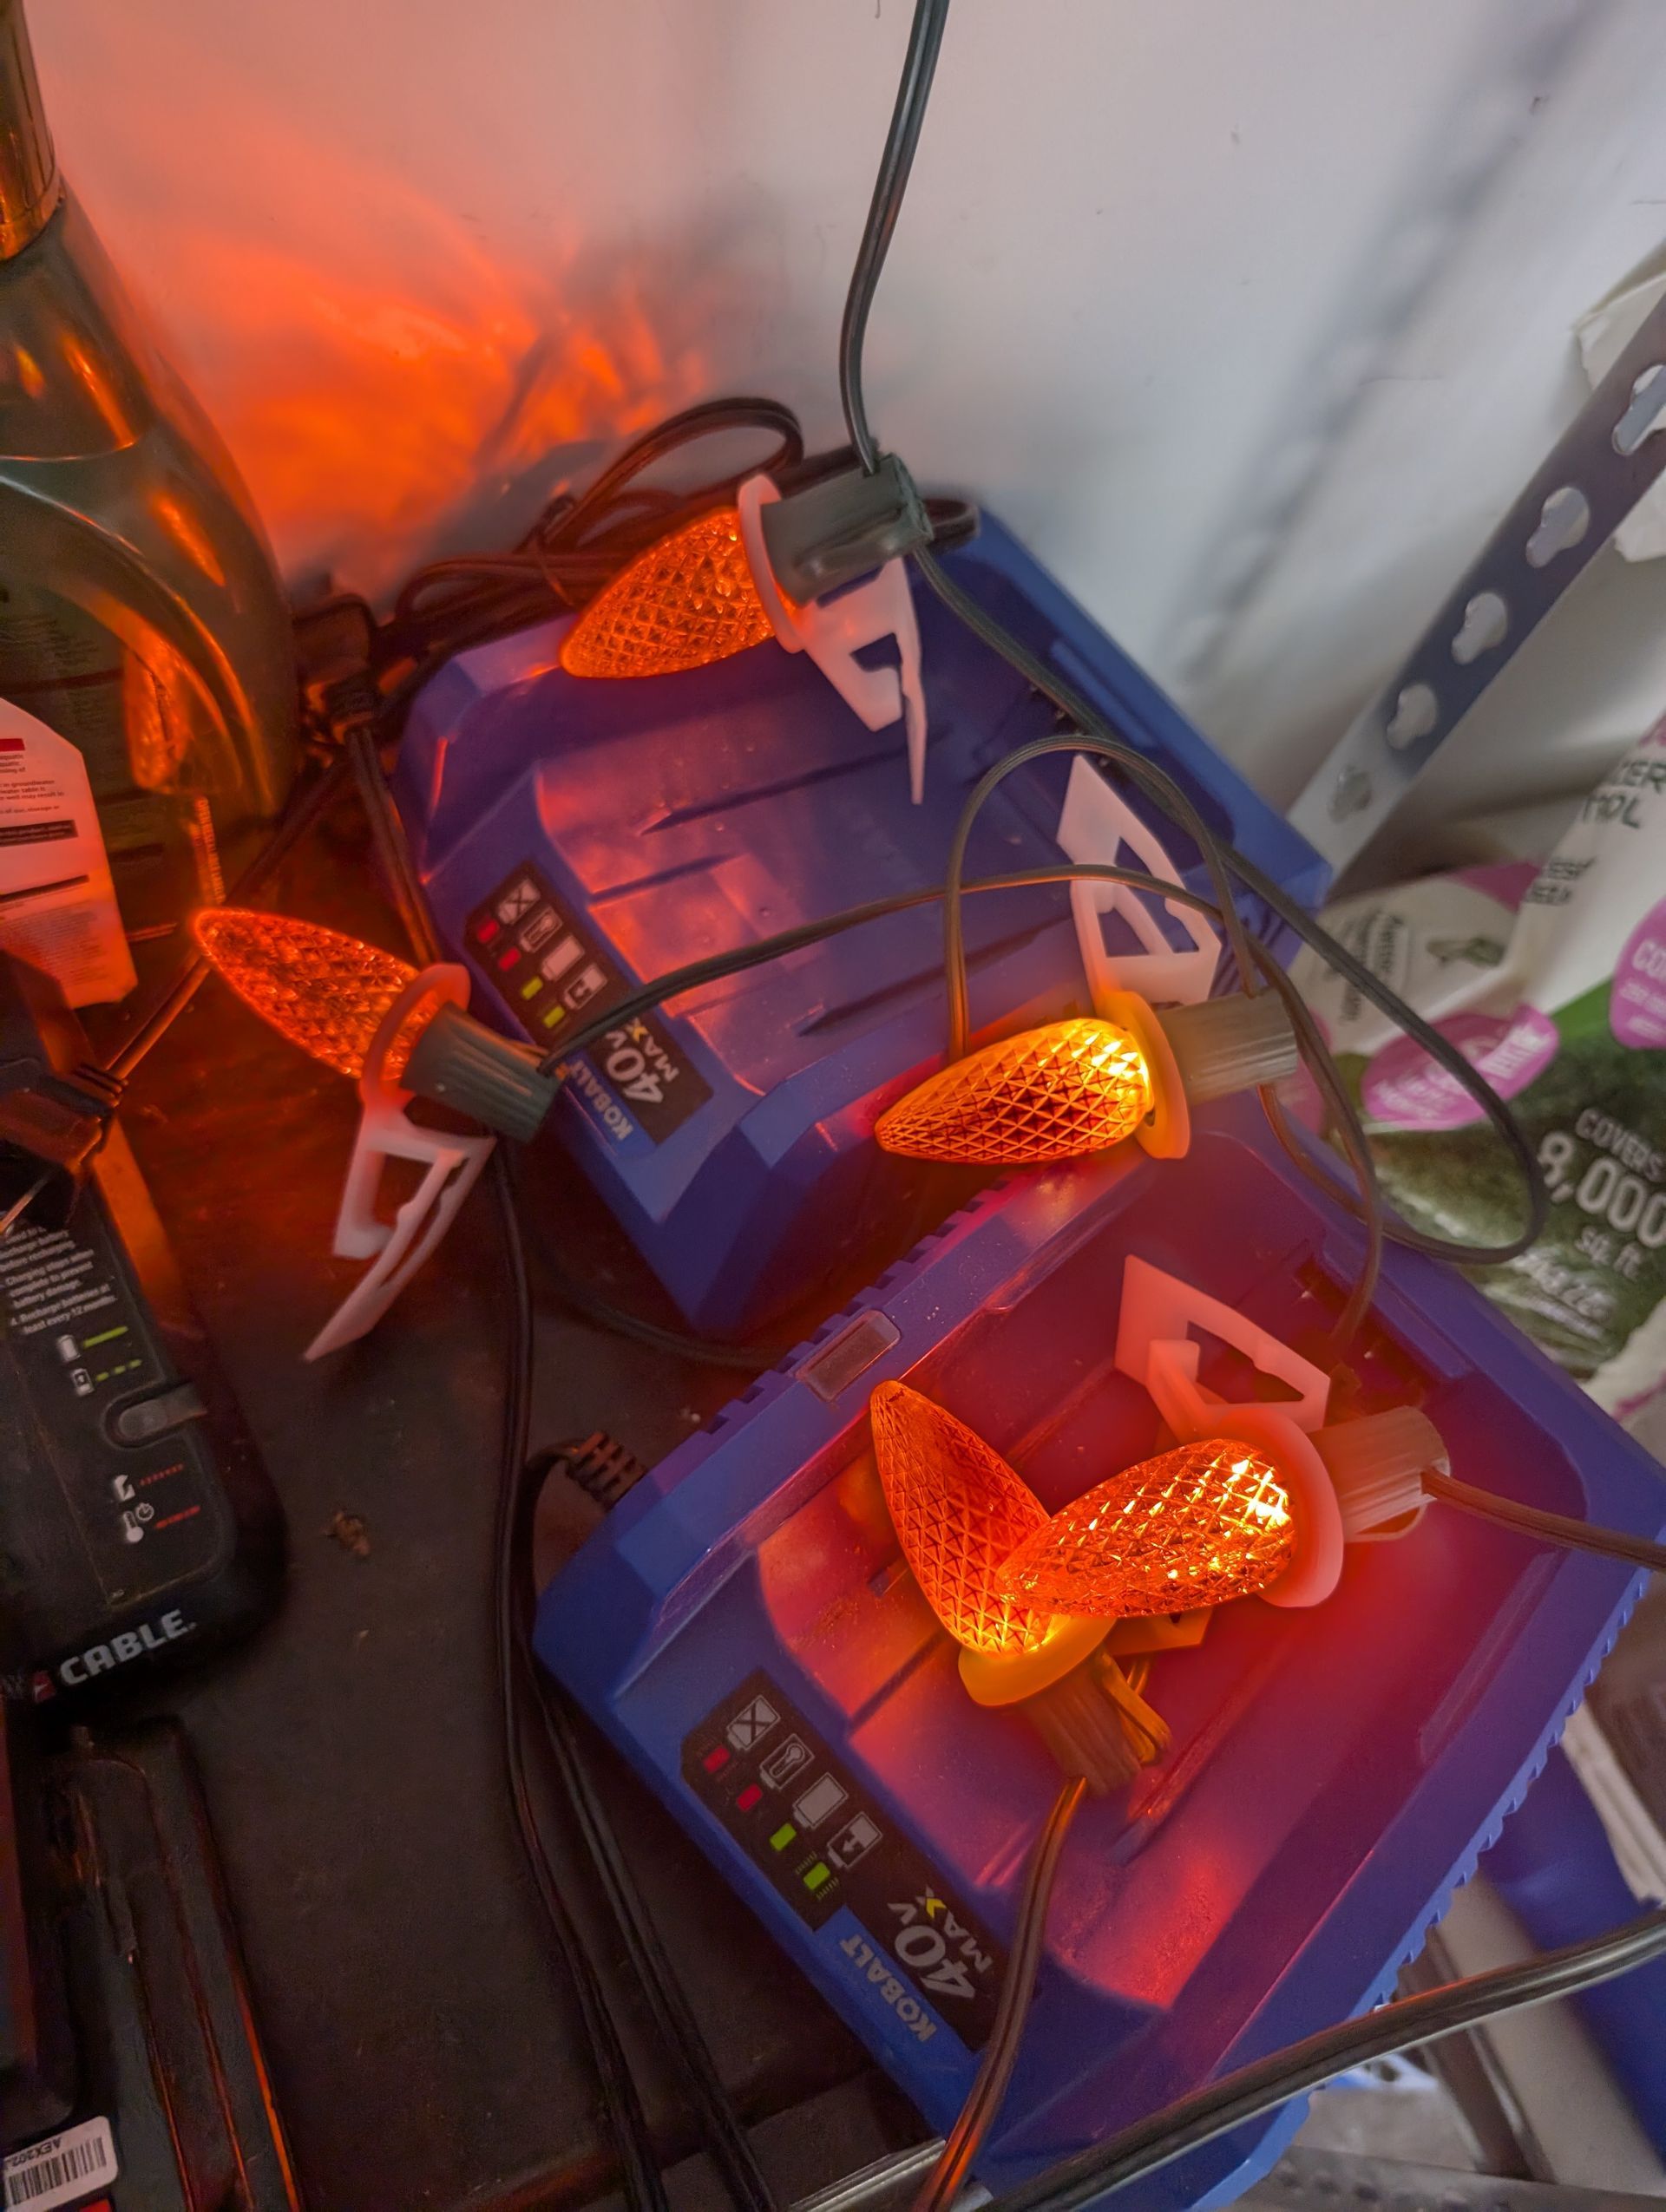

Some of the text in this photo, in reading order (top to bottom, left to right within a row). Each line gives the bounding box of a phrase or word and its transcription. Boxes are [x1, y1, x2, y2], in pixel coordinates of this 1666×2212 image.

[625, 1017, 679, 1082] MAX
[569, 1059, 634, 1142] KOBALT
[1537, 1130, 1666, 1249] 9,000
[887, 1901, 976, 1999] 40V
[915, 1883, 994, 1973] MAX
[839, 1934, 937, 2042] KOBALT
